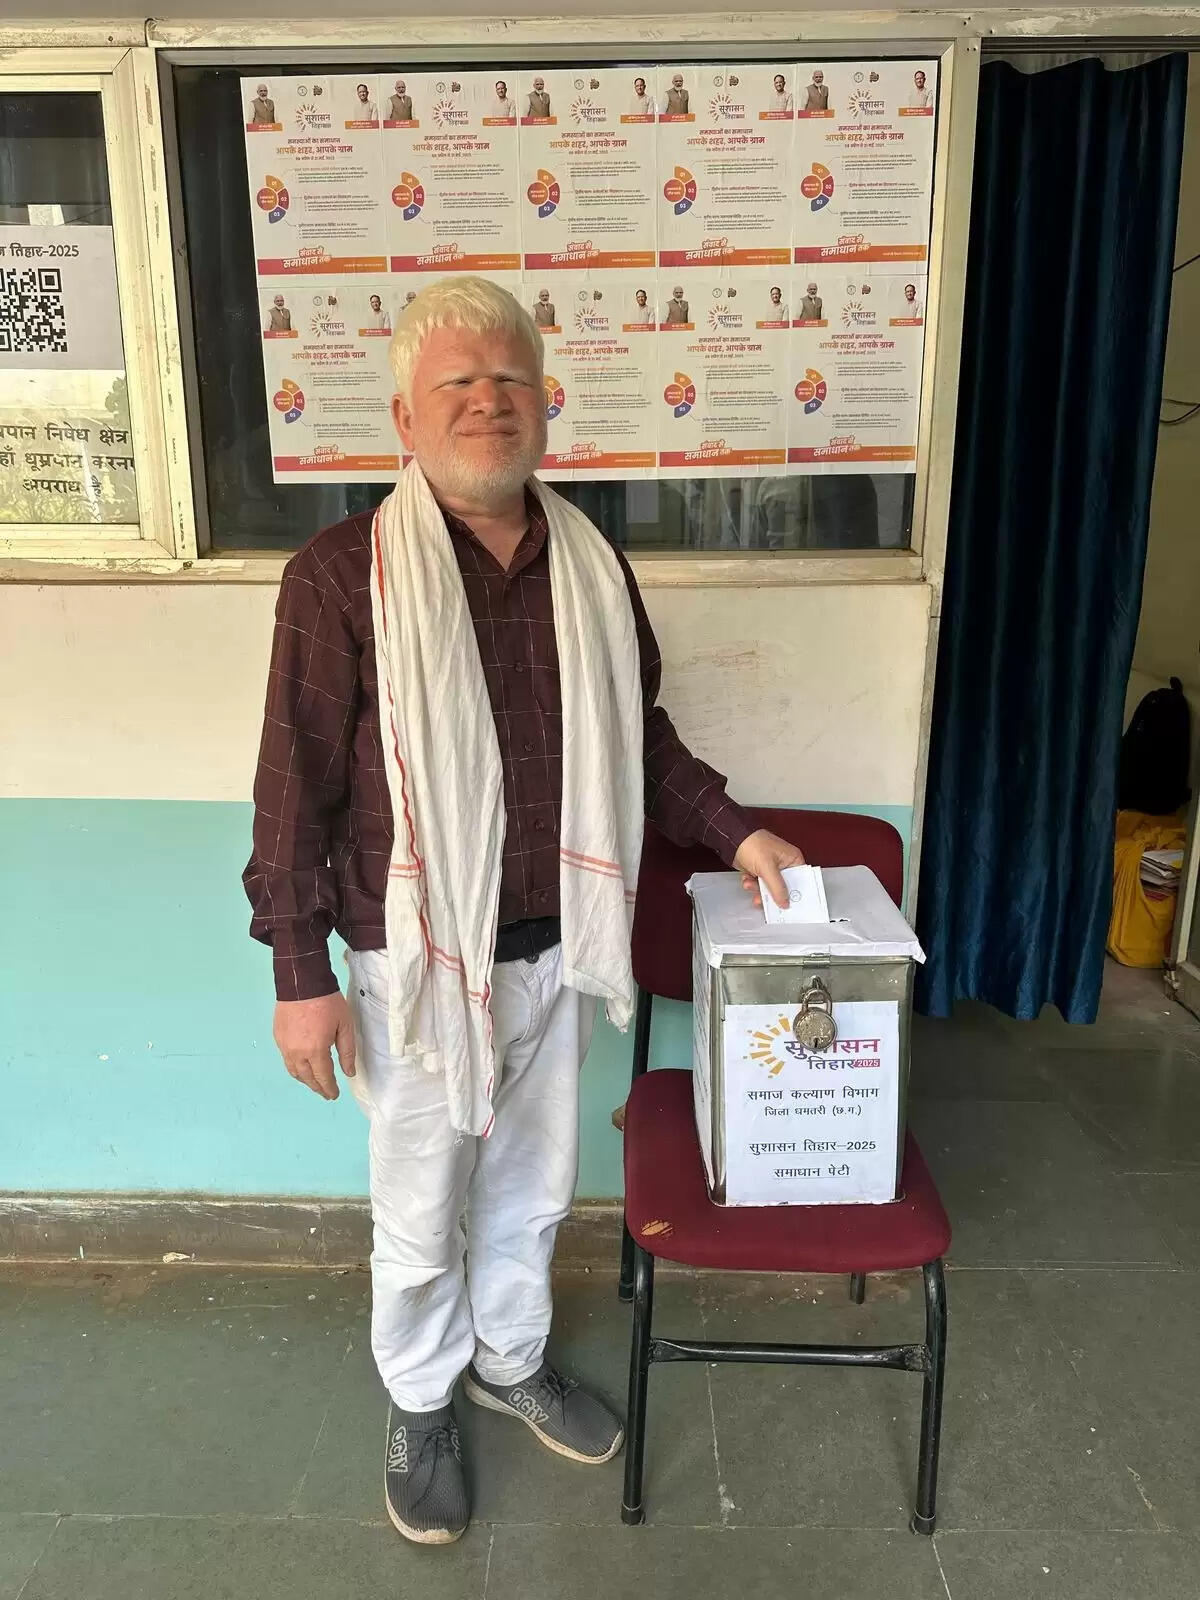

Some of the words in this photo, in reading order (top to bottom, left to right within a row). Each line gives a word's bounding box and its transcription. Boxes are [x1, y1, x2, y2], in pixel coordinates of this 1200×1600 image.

[858, 100, 884, 111] सुशासन
[580, 107, 605, 119] सुशासन
[304, 114, 330, 125] सुशासन
[866, 131, 886, 140] आपके
[315, 144, 336, 153] आपके
[589, 138, 610, 147] आपके
[820, 244, 856, 256] समाधान
[282, 256, 318, 268] समाधान
[550, 251, 585, 262] समाधान
[99, 423, 129, 446] क्षेत्र
[807, 1056, 855, 1070] तिहार
[856, 1059, 880, 1067] 2025
[747, 1089, 783, 1100] समाज
[790, 1088, 835, 1099] कल्याण
[842, 1085, 880, 1098] विभाग
[764, 1106, 789, 1116] जिला
[794, 1105, 826, 1115] धमतरी
[832, 1104, 862, 1116] (छ.ग.)
[749, 1142, 796, 1155] सुशासन
[774, 1168, 820, 1177] समाधान
[828, 1164, 850, 1176] पेटी
